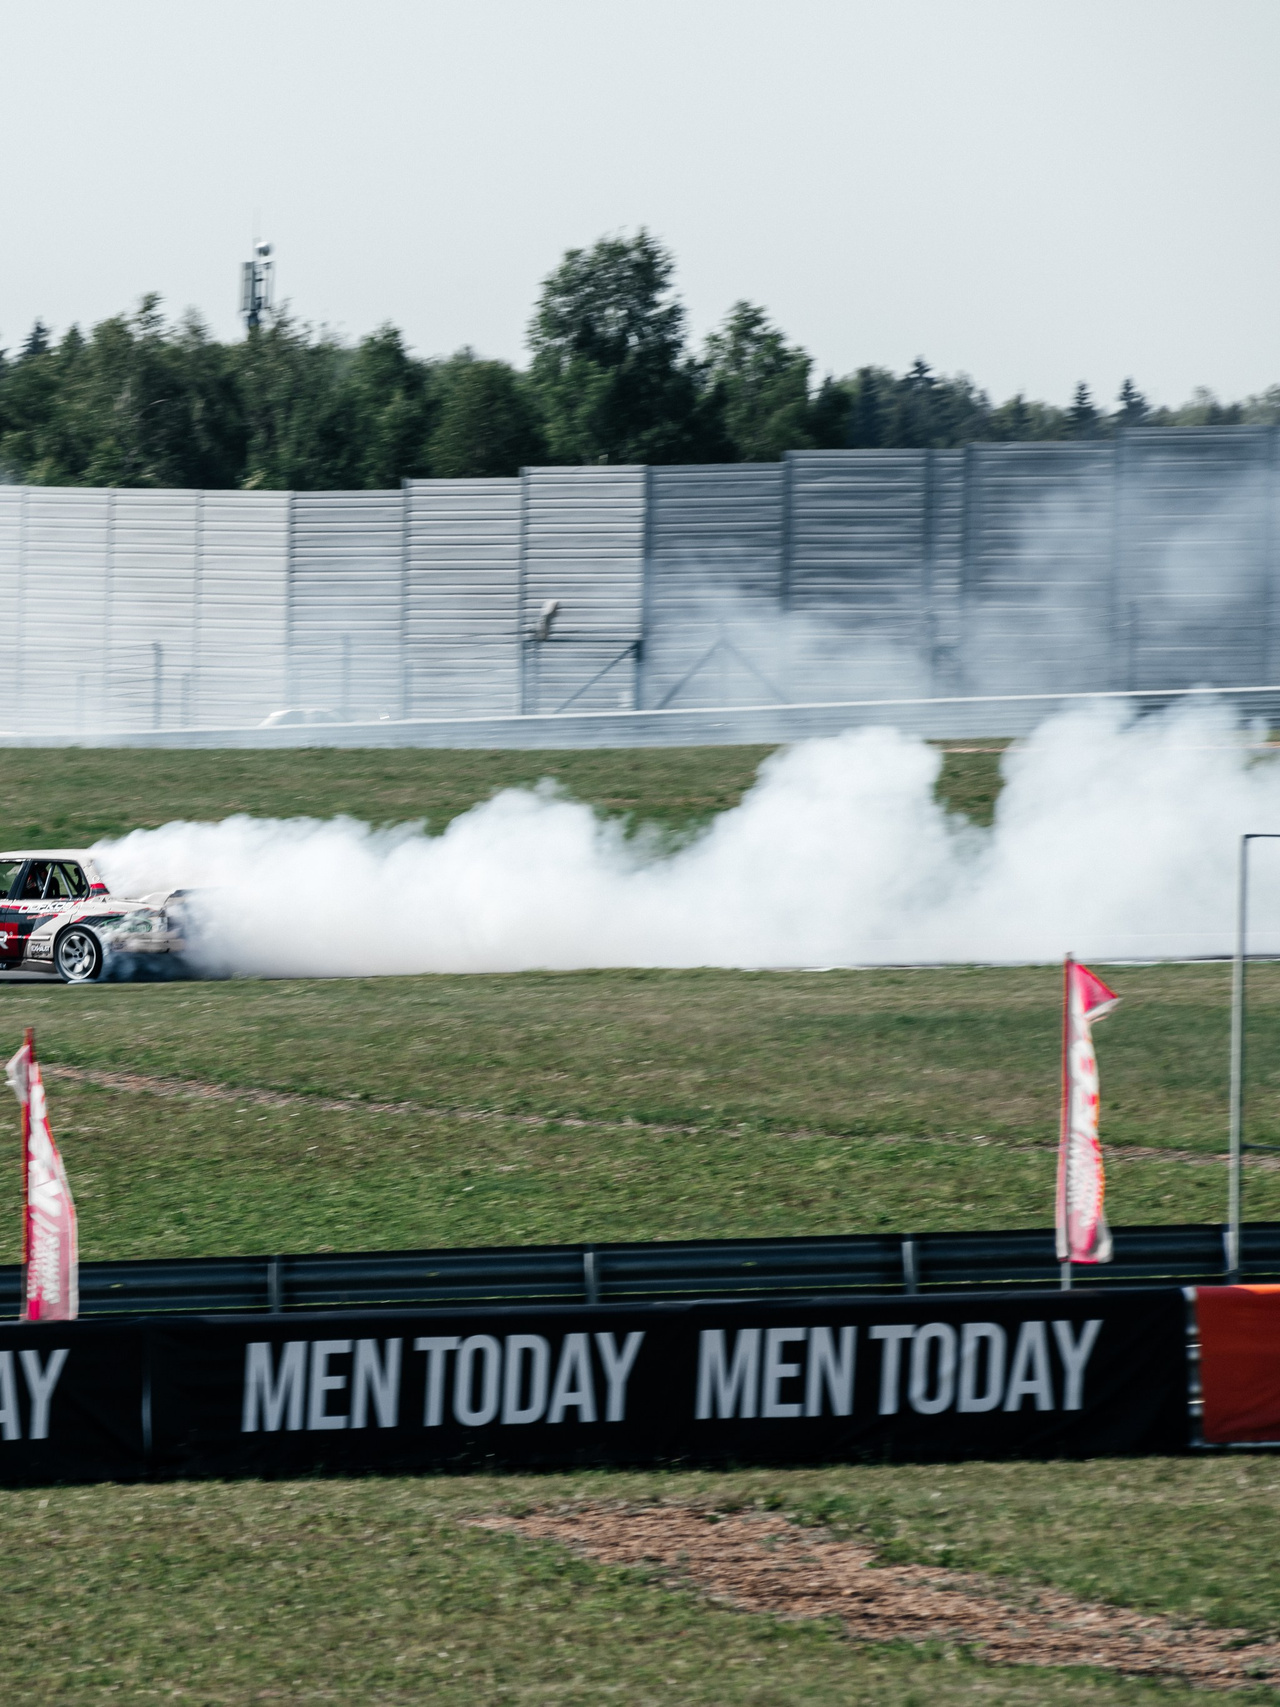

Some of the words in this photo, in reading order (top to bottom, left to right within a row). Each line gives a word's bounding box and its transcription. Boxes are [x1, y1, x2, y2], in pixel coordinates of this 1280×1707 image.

[243, 1337, 400, 1432] MEN
[415, 1331, 644, 1428] TODAY
[697, 1326, 857, 1421] MEN
[869, 1319, 1102, 1416] TODAY
